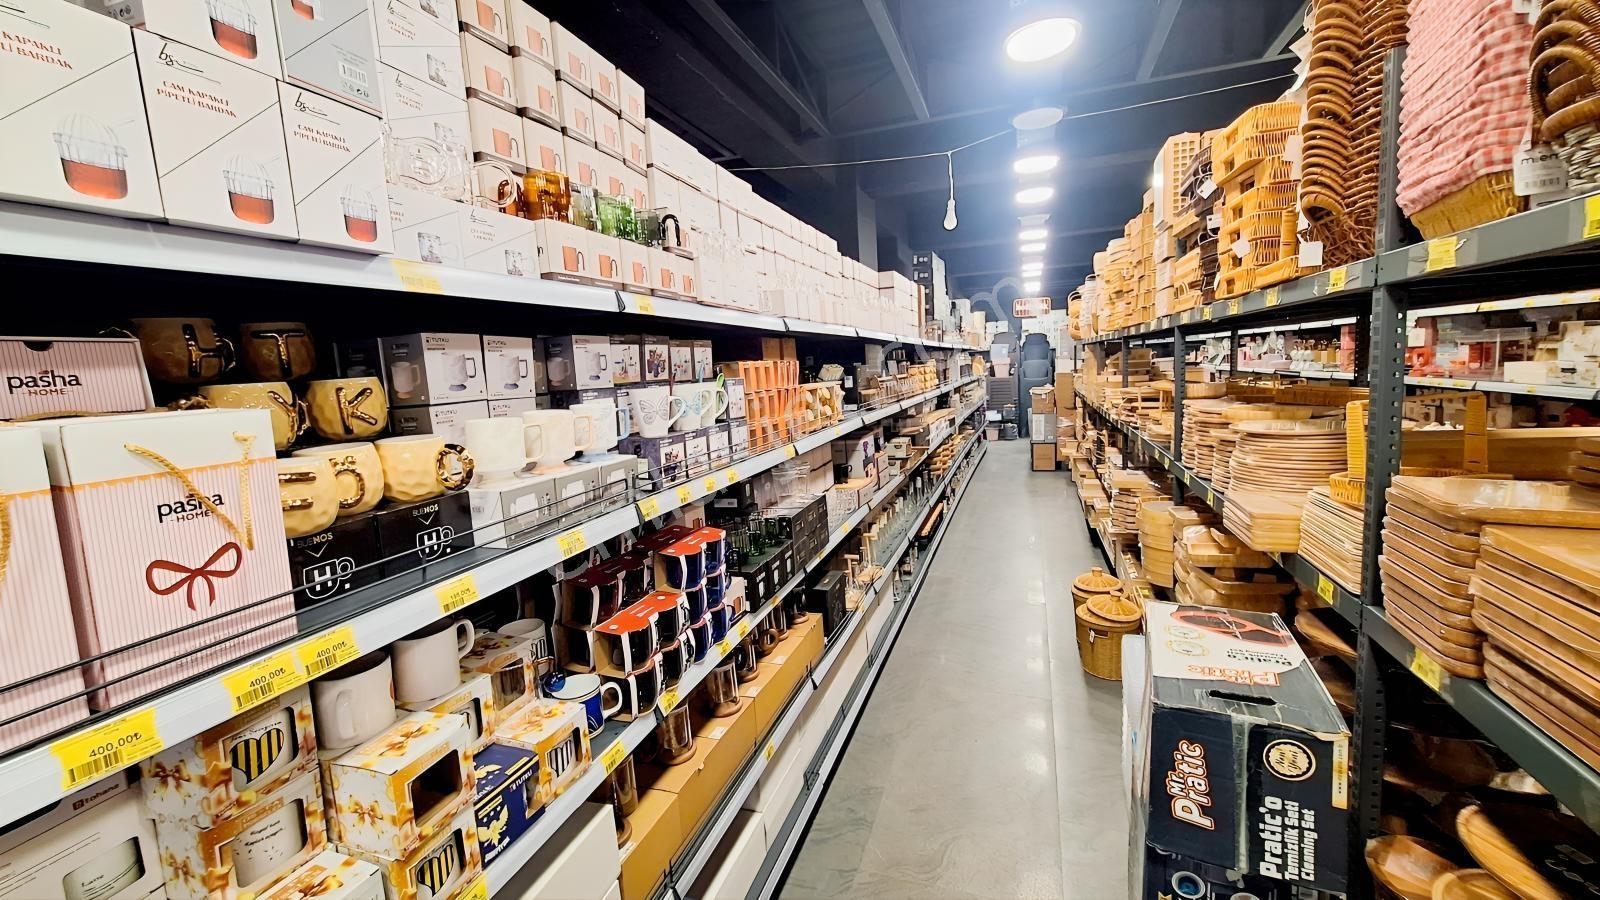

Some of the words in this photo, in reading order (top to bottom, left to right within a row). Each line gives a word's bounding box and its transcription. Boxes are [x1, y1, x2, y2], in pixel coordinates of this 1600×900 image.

[16, 47, 73, 70] BARDAK
[6, 369, 83, 395] pasha
[335, 386, 378, 435] K
[1166, 770, 1187, 798] Mr.
[1171, 740, 1215, 831] Pratic
[1258, 795, 1283, 880] Pratic'o
[1301, 808, 1315, 829] Set
[1284, 828, 1300, 881] Temizlik
